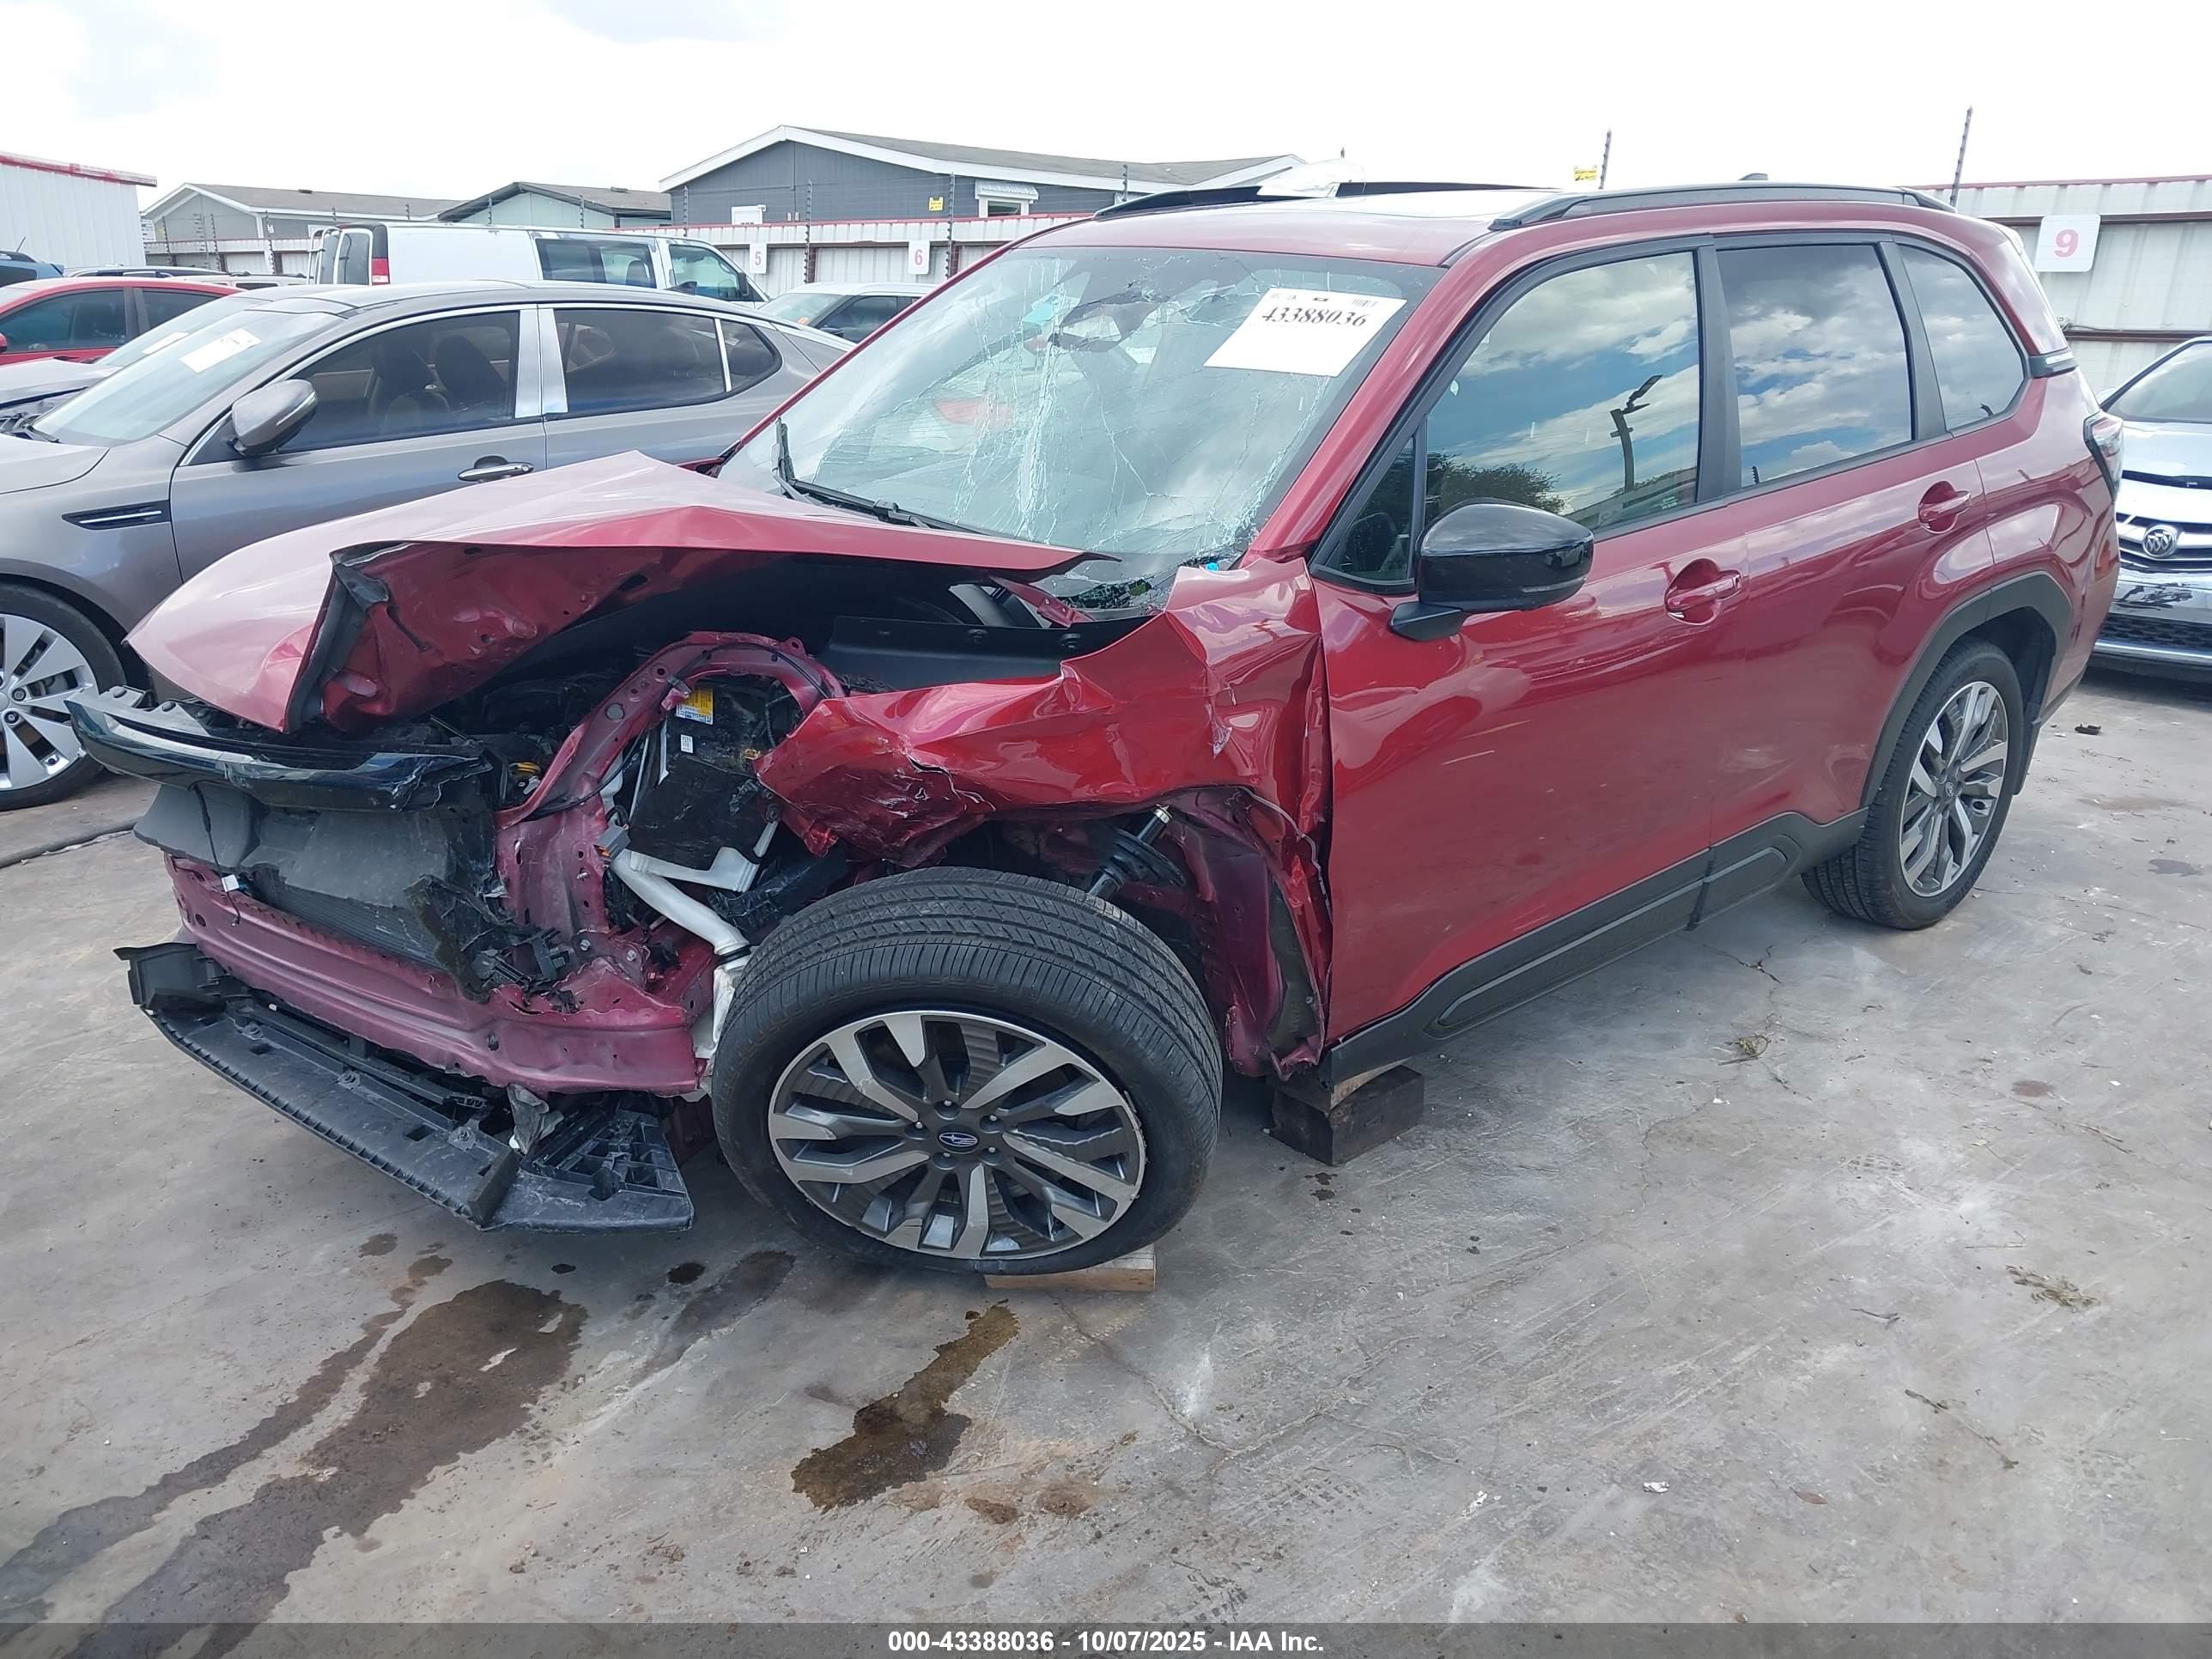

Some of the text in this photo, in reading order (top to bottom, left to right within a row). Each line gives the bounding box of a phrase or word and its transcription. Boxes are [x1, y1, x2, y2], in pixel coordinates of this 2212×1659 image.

[2054, 228, 2079, 258] 9
[755, 251, 762, 266] 5
[914, 248, 923, 266] 6
[1261, 306, 1370, 327] 43388036
